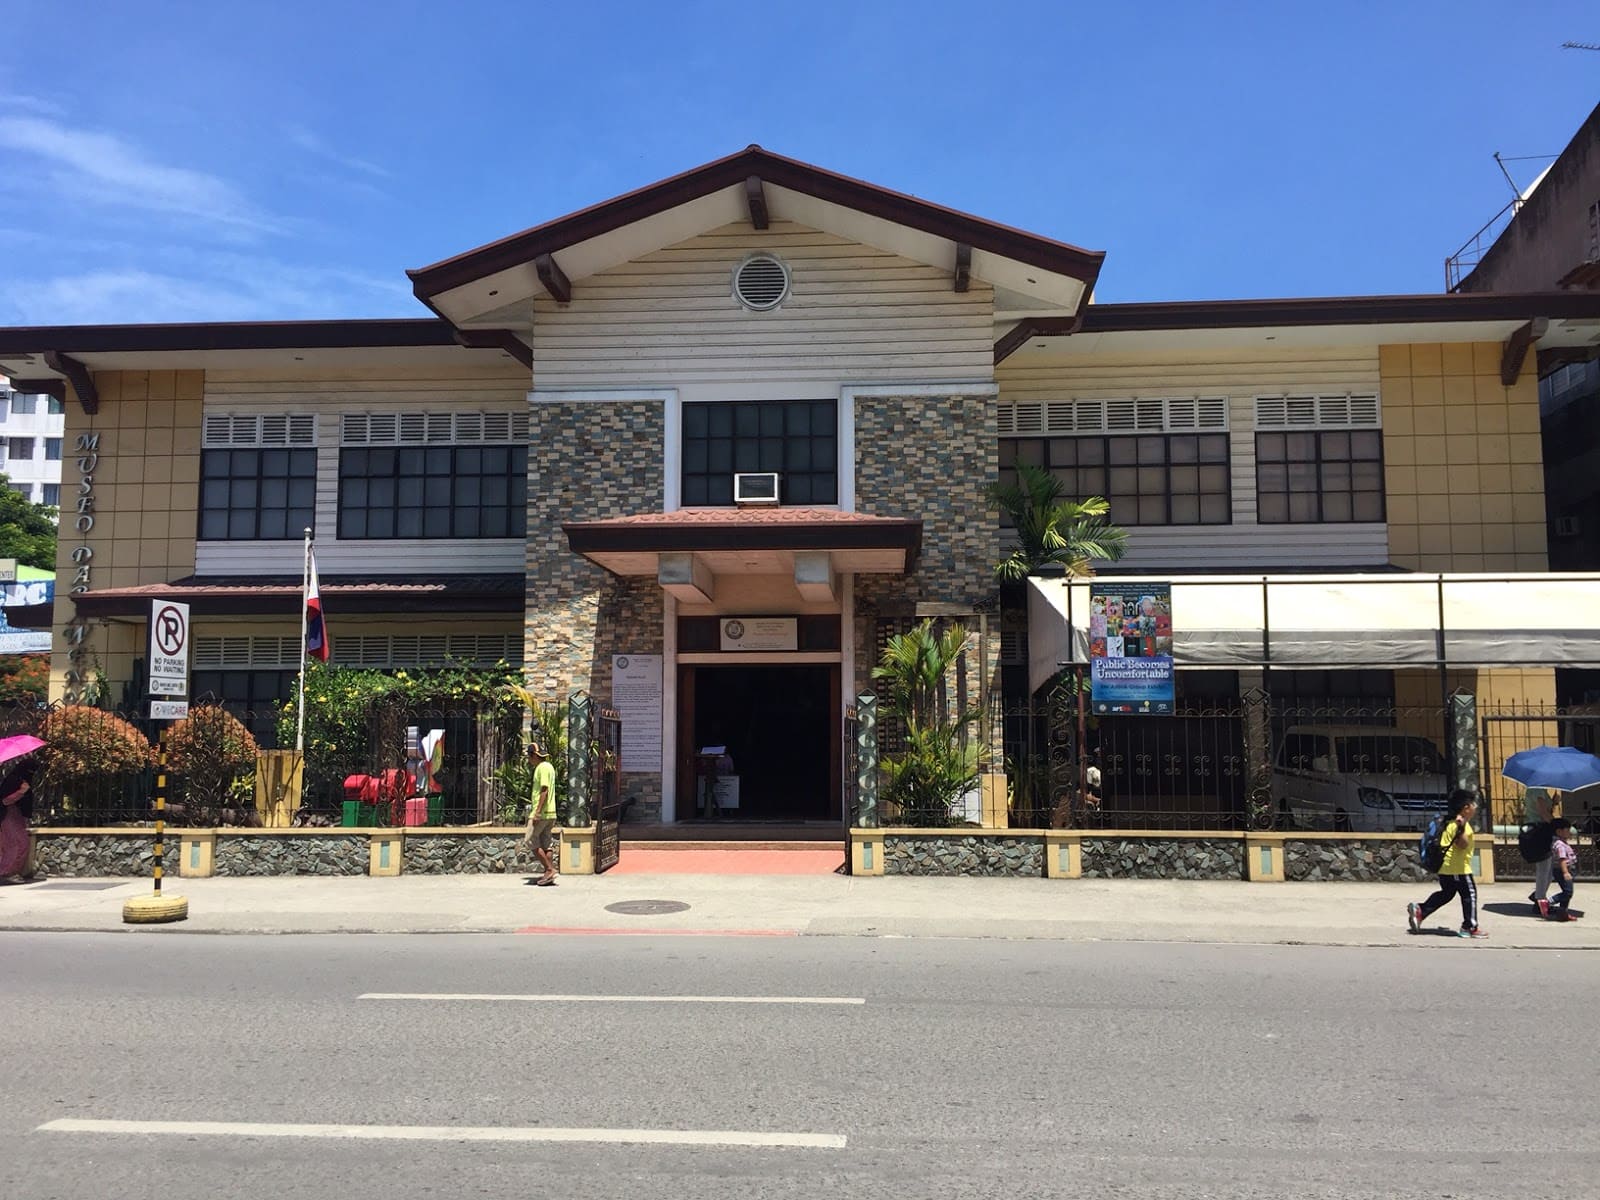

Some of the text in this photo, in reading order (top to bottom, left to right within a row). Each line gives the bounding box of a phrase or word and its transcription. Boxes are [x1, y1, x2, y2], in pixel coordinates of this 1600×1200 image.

[73, 431, 99, 533] MUSEO
[163, 658, 184, 667] PARKING
[1096, 659, 1170, 669] Public Becomes
[154, 665, 184, 674] NO WAITING
[1097, 669, 1170, 679] Uncomfortable
